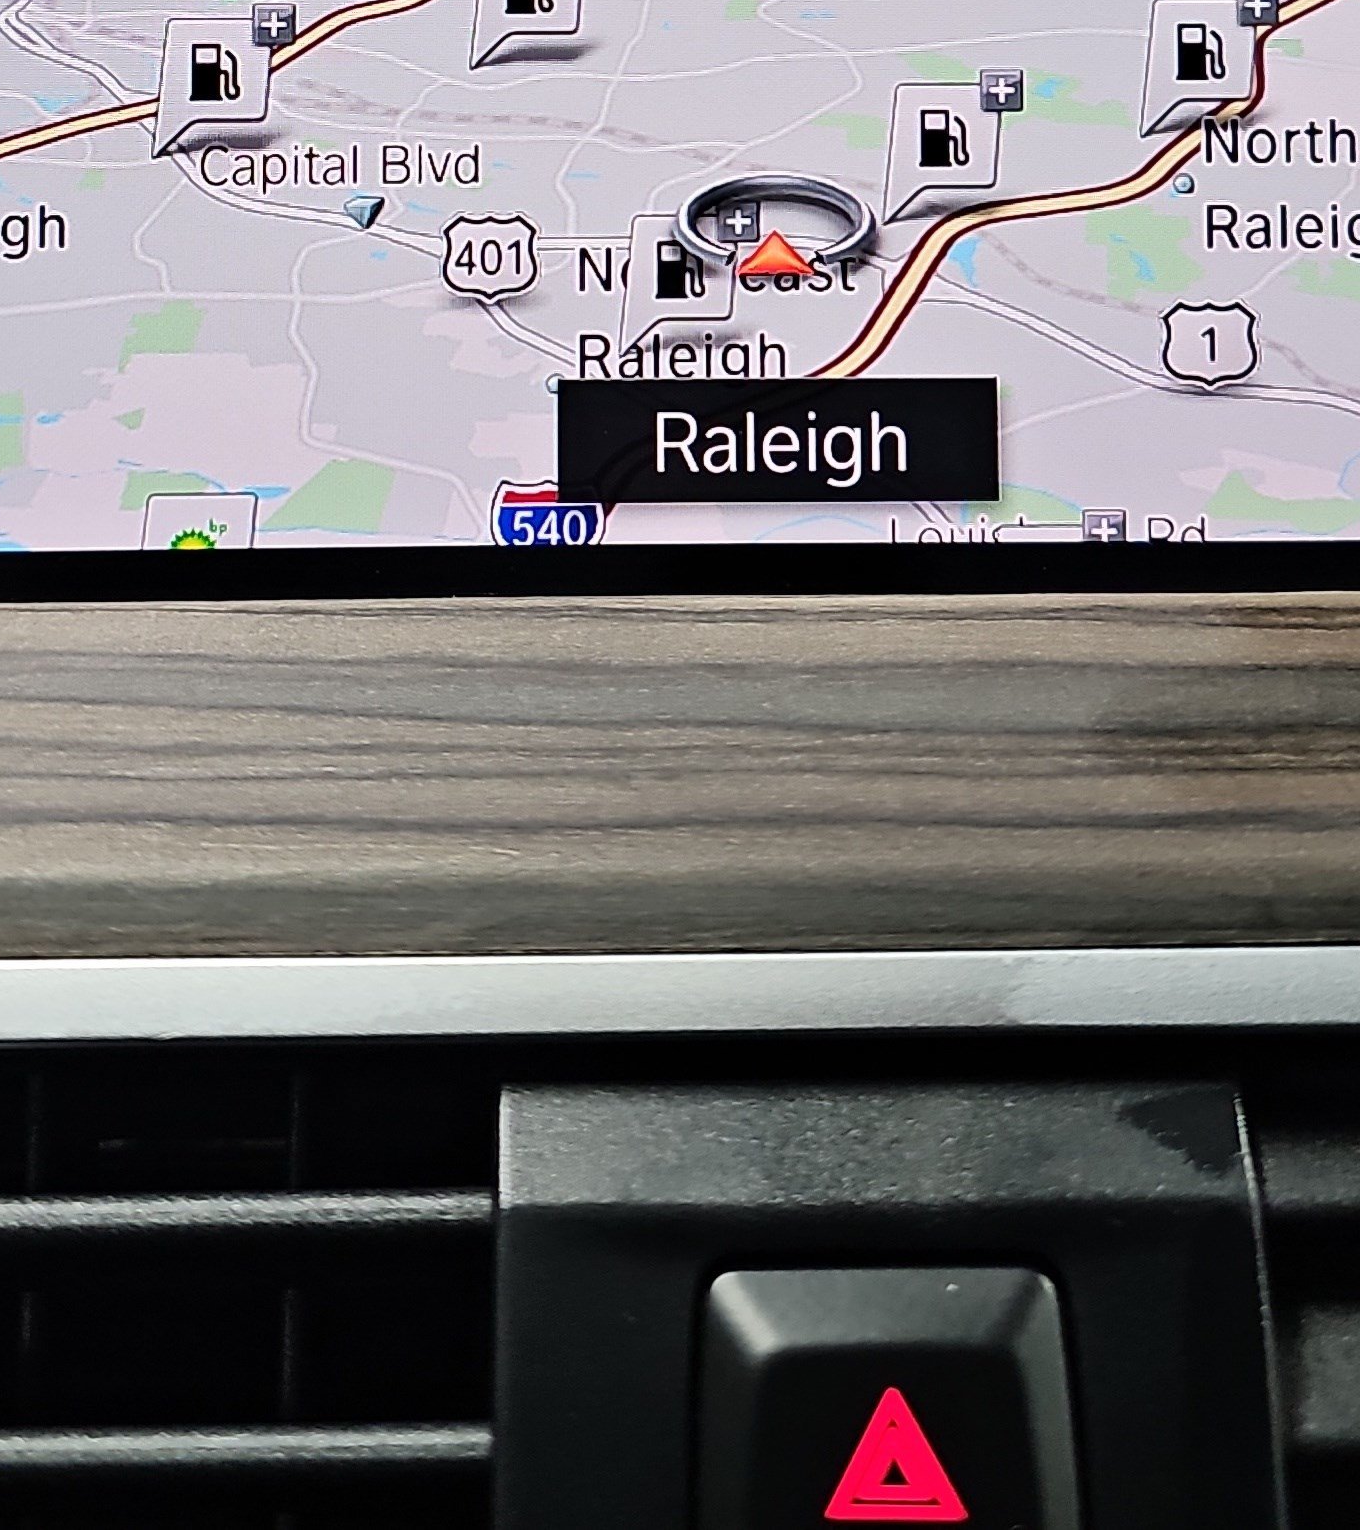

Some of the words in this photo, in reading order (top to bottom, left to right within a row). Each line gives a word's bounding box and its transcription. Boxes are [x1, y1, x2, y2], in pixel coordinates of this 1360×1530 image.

[1204, 121, 1356, 164] North
[201, 145, 361, 193] Capital
[382, 145, 480, 186] Blvd
[455, 240, 526, 276] 401
[1200, 326, 1217, 362] 1
[655, 411, 908, 487] Raleigh
[513, 510, 587, 545] 540
